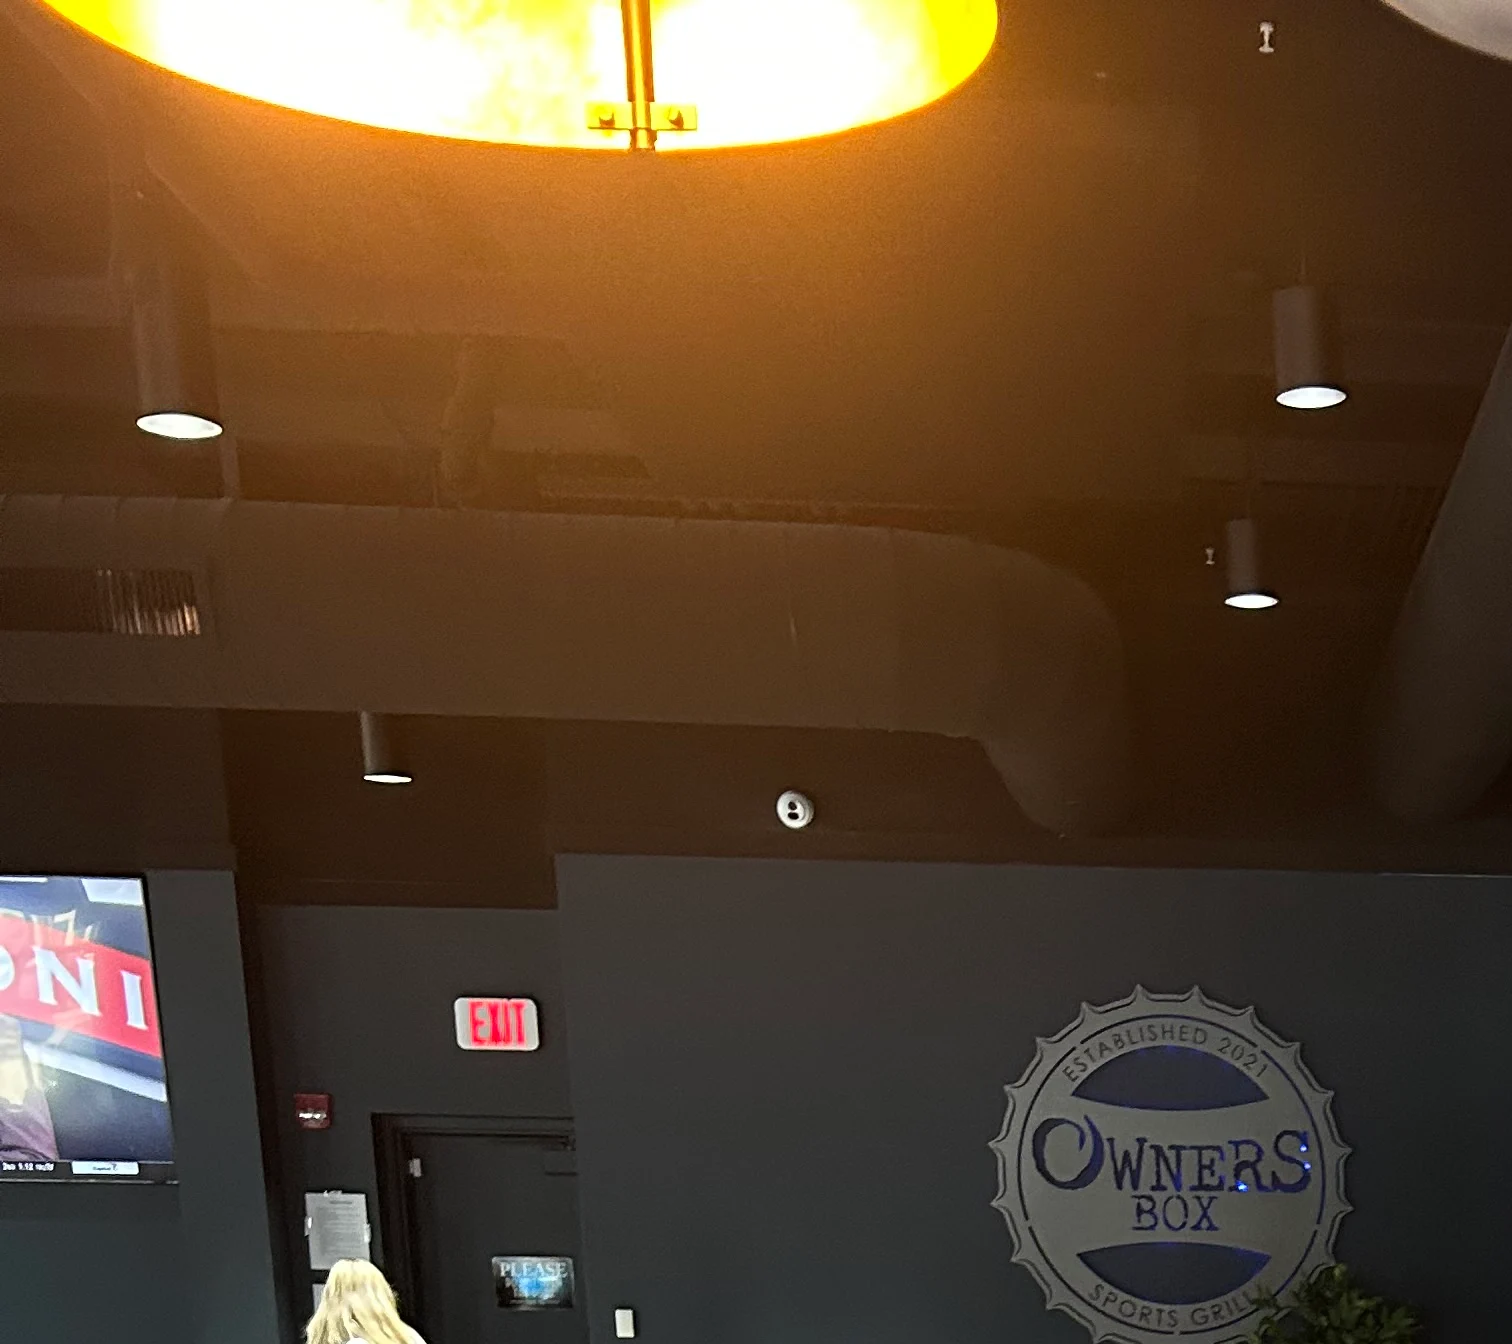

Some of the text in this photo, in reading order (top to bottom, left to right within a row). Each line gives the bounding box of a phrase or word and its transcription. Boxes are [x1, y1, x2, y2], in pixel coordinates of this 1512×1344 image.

[469, 1000, 527, 1047] EXIT
[1062, 1023, 1270, 1082] ESTABLISHED 2021
[1131, 1195, 1220, 1232] BOX
[500, 1262, 568, 1278] PLEASE
[1088, 1284, 1180, 1327] SPORTS
